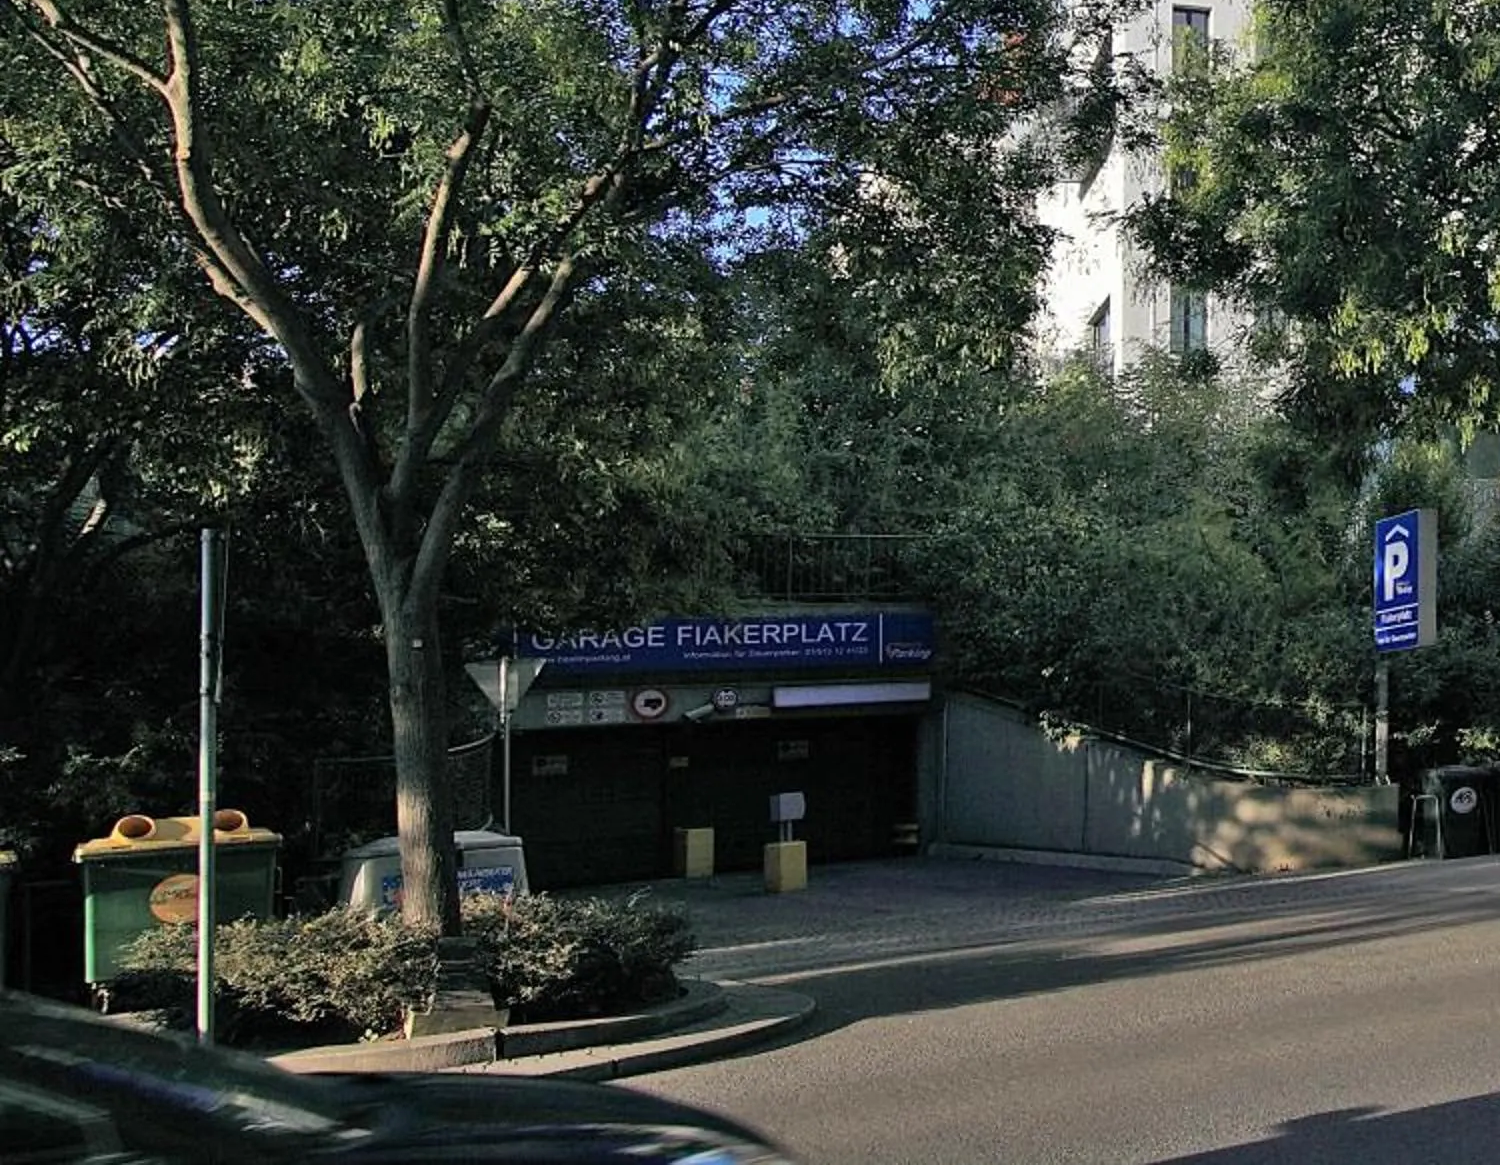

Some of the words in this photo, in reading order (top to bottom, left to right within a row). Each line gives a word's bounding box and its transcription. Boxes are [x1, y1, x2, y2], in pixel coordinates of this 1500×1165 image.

[1383, 540, 1409, 602] P
[531, 626, 665, 650] GARAGE
[677, 622, 869, 647] FIAKERPLATZ
